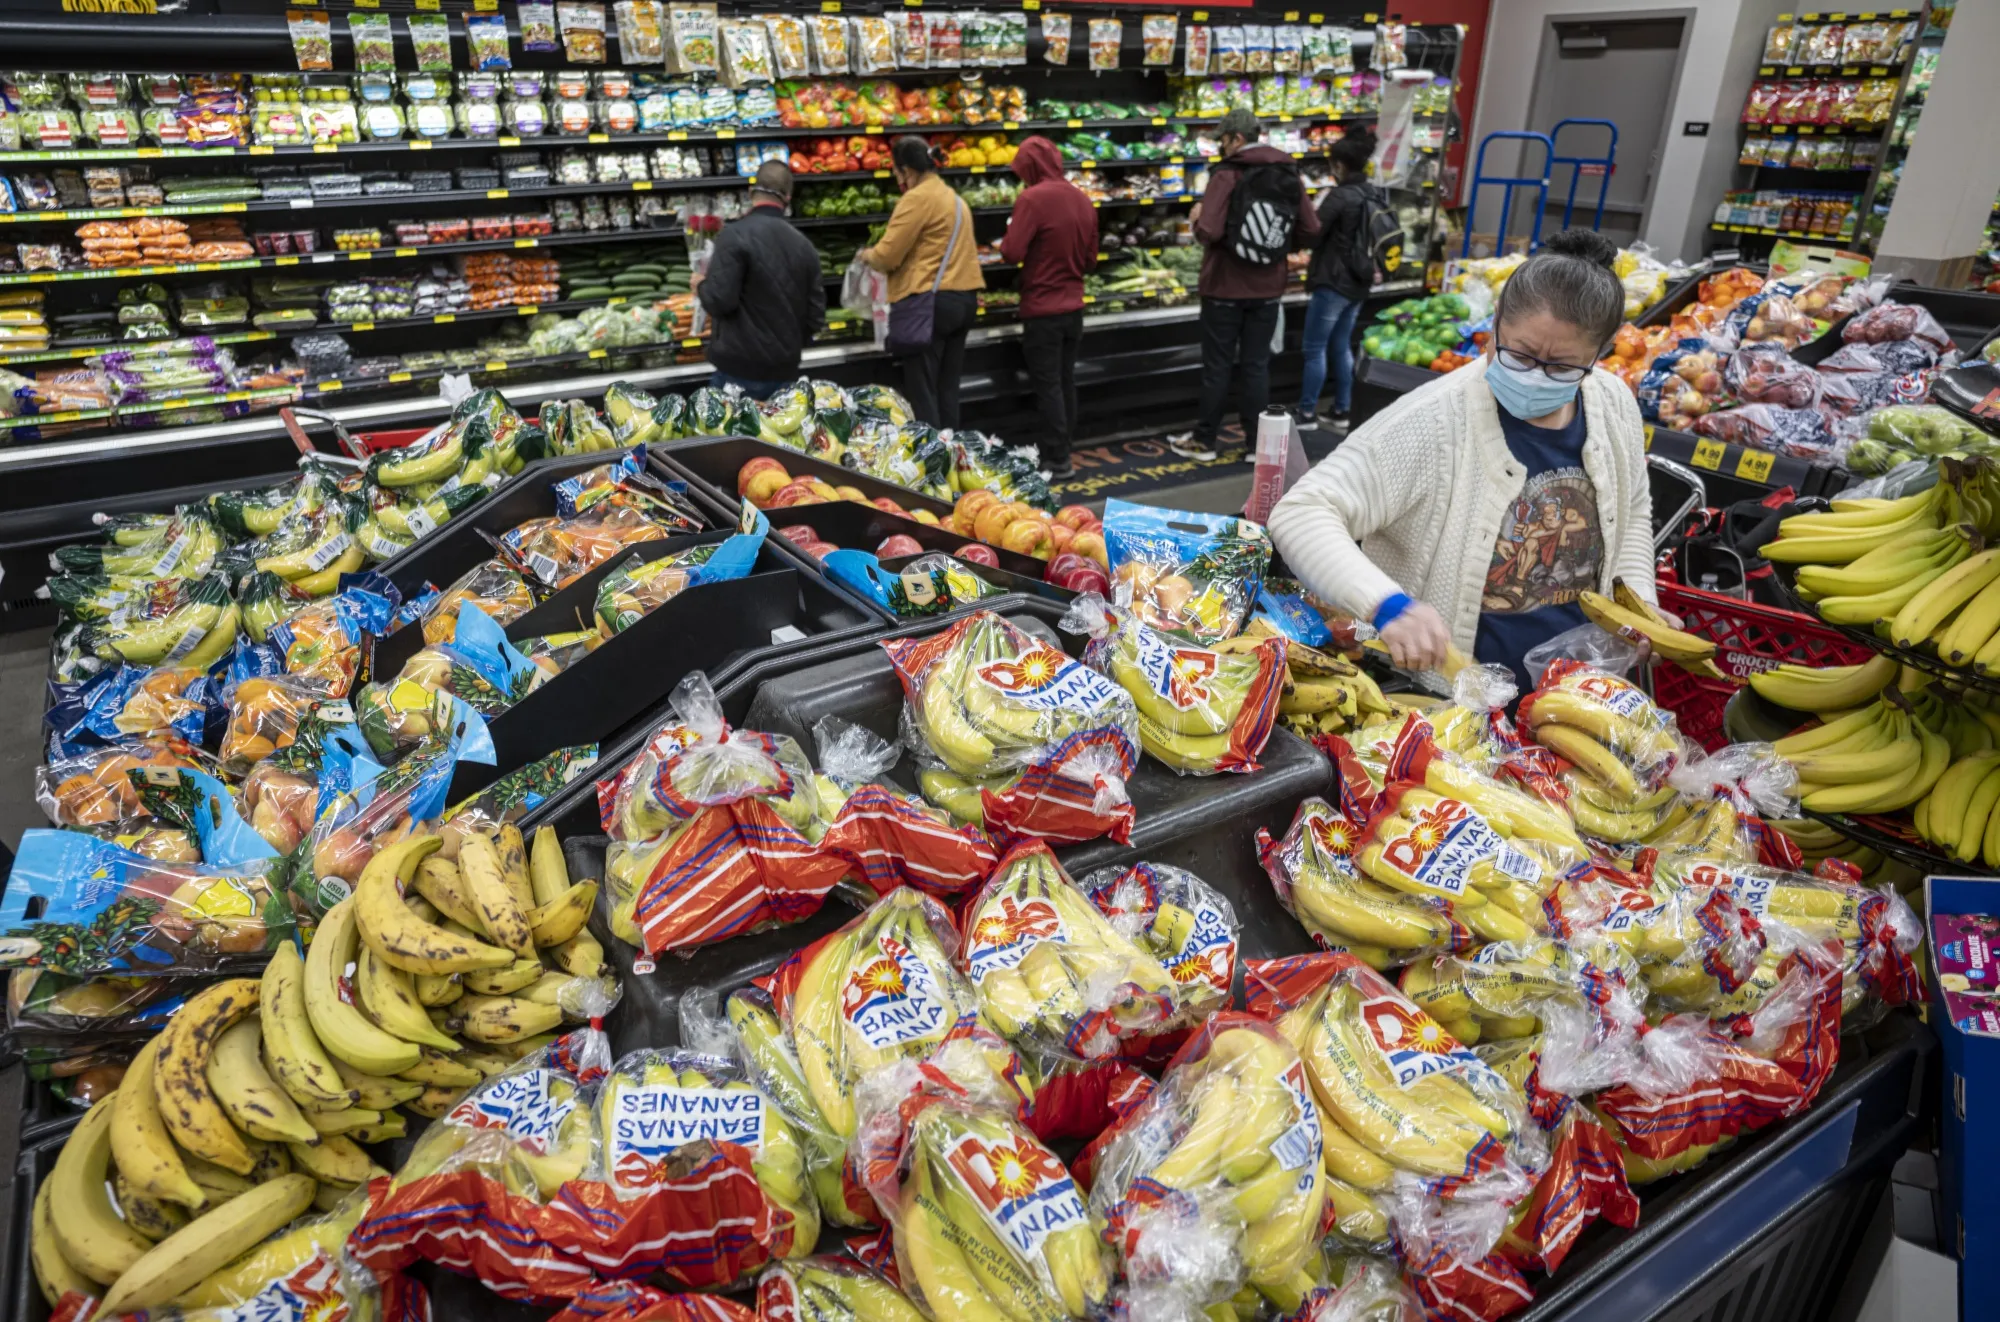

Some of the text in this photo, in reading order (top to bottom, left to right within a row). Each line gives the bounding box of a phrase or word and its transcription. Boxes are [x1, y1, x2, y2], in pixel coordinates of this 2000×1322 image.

[1382, 799, 1467, 876] Dole
[1425, 820, 1488, 886] BANANAS
[326, 880, 346, 899] USDA
[1967, 934, 1984, 969] CHOCOLATE
[622, 1092, 760, 1114] BANANES
[617, 1116, 760, 1139] BANANAS
[967, 1235, 981, 1248] BY
[980, 1244, 1005, 1267] DOLE
